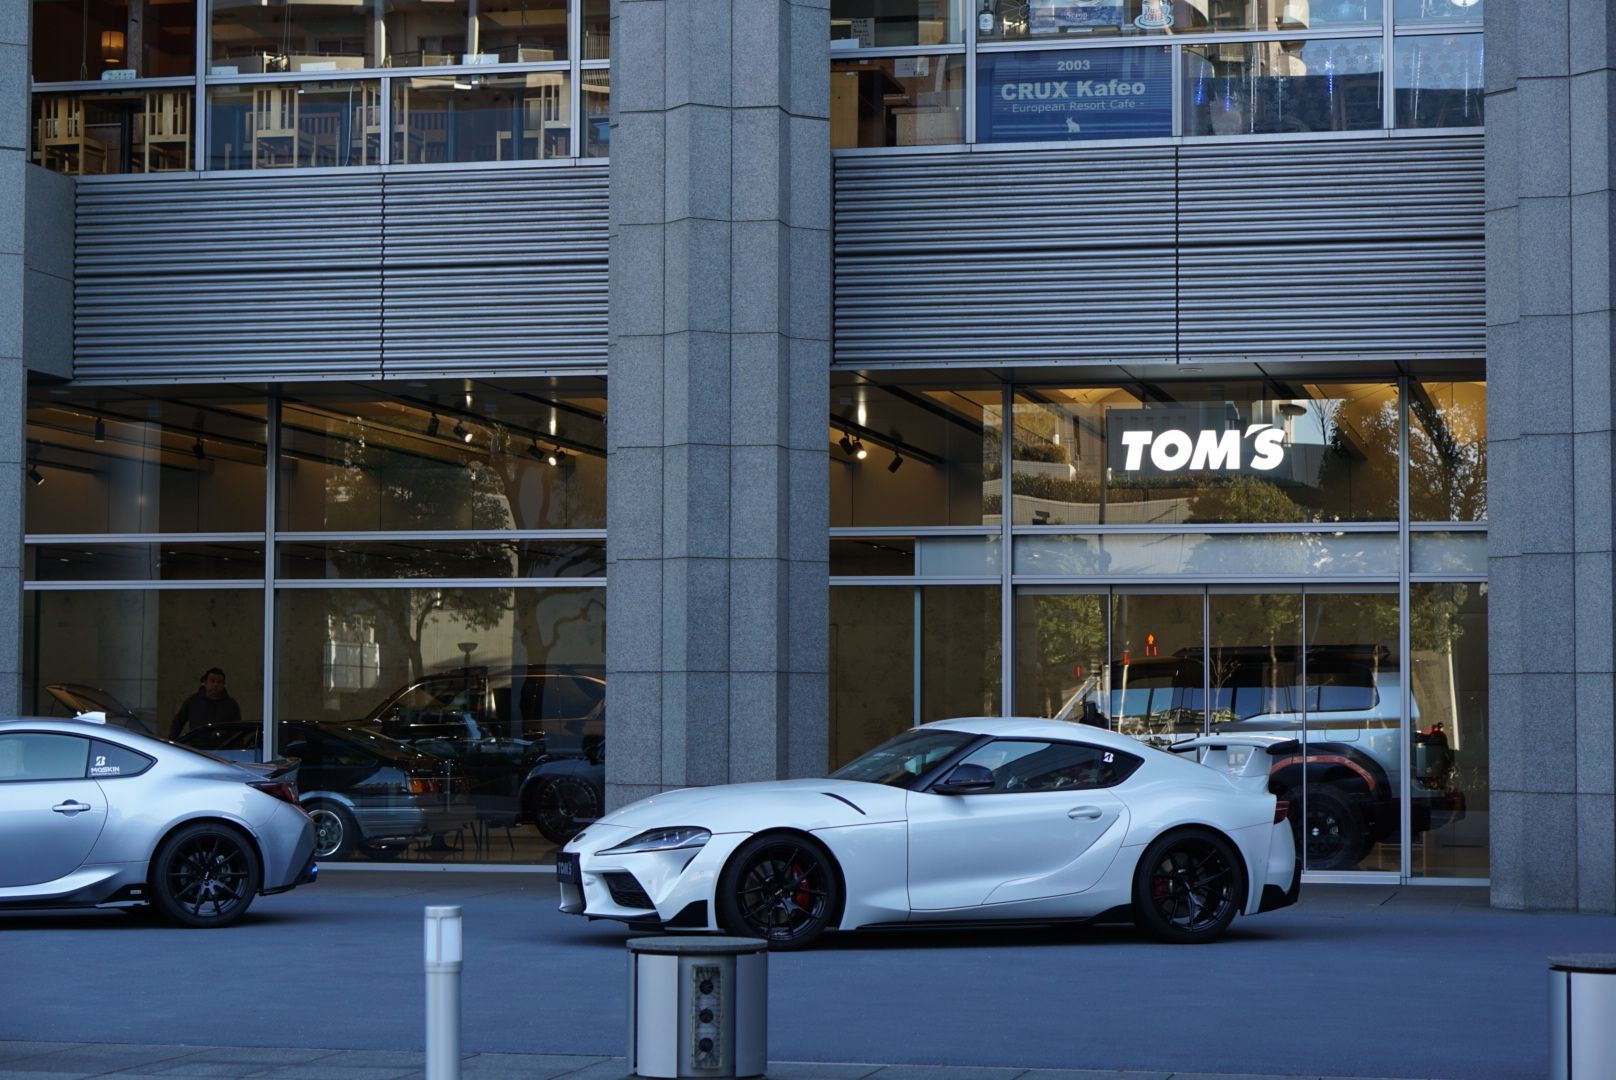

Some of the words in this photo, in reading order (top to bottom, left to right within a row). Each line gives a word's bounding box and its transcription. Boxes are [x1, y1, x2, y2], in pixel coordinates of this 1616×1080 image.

[1057, 60, 1090, 71] 2003
[1001, 81, 1069, 100] CRUX
[1077, 79, 1146, 97] Kafeo
[1012, 103, 1065, 113] European
[1069, 101, 1106, 111] Resort
[1110, 99, 1136, 109] Cafe
[1121, 424, 1286, 471] TOM'S
